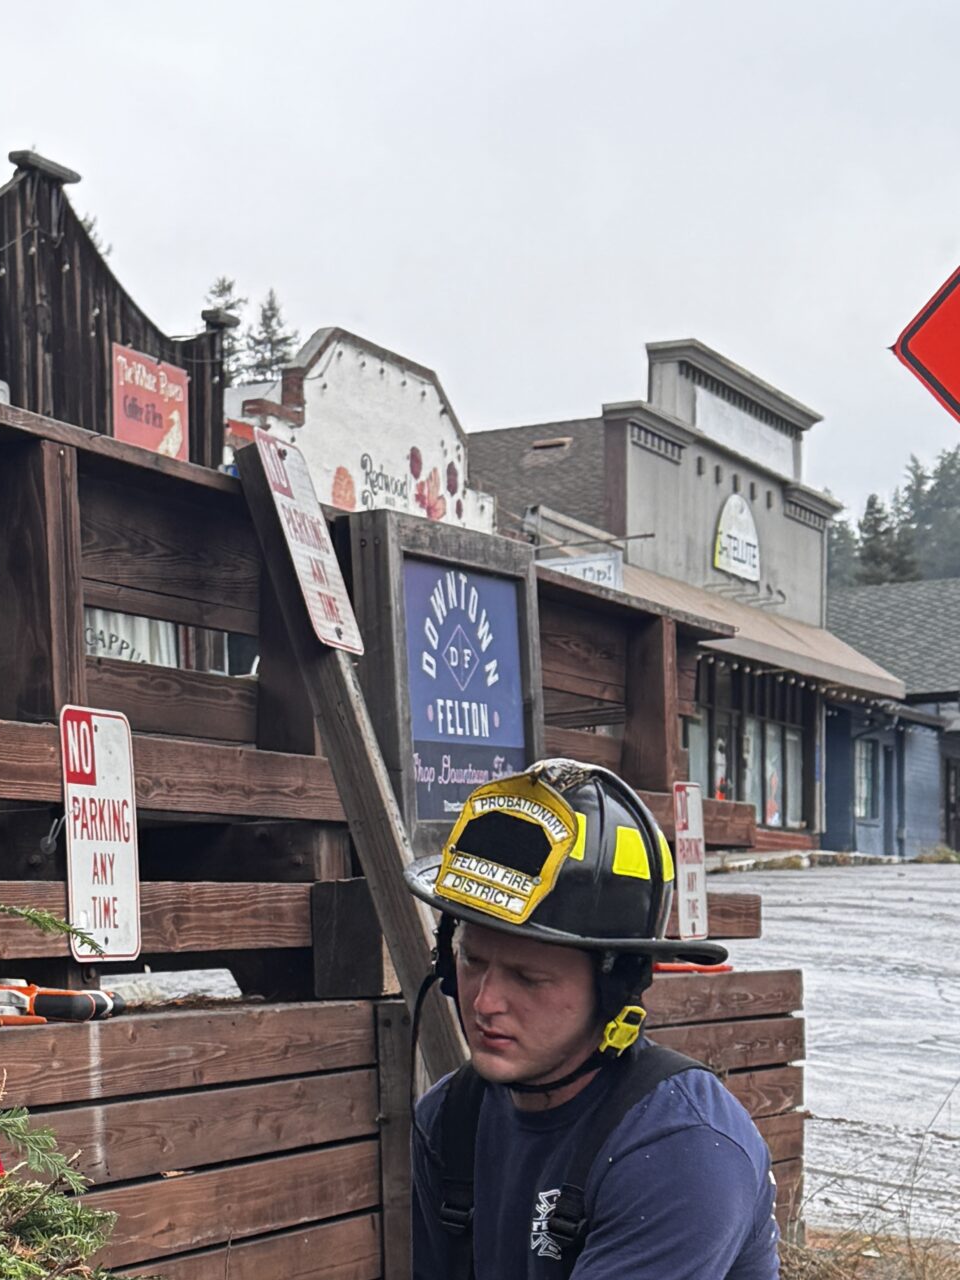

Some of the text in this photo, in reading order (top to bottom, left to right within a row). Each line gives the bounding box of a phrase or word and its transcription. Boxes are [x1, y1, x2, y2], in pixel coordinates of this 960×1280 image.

[360, 453, 409, 500] Redwood
[280, 502, 331, 555] PARKING
[422, 571, 499, 687] DOWNTOWN
[436, 698, 490, 738] FELTON
[66, 720, 92, 775] NO
[72, 797, 130, 842] PARKING
[480, 797, 567, 836] PROBATIONARY
[92, 852, 115, 886] ANY
[453, 857, 531, 893] FELTON FIRE
[451, 875, 517, 908] DISTRICT
[91, 896, 119, 929] TIME
